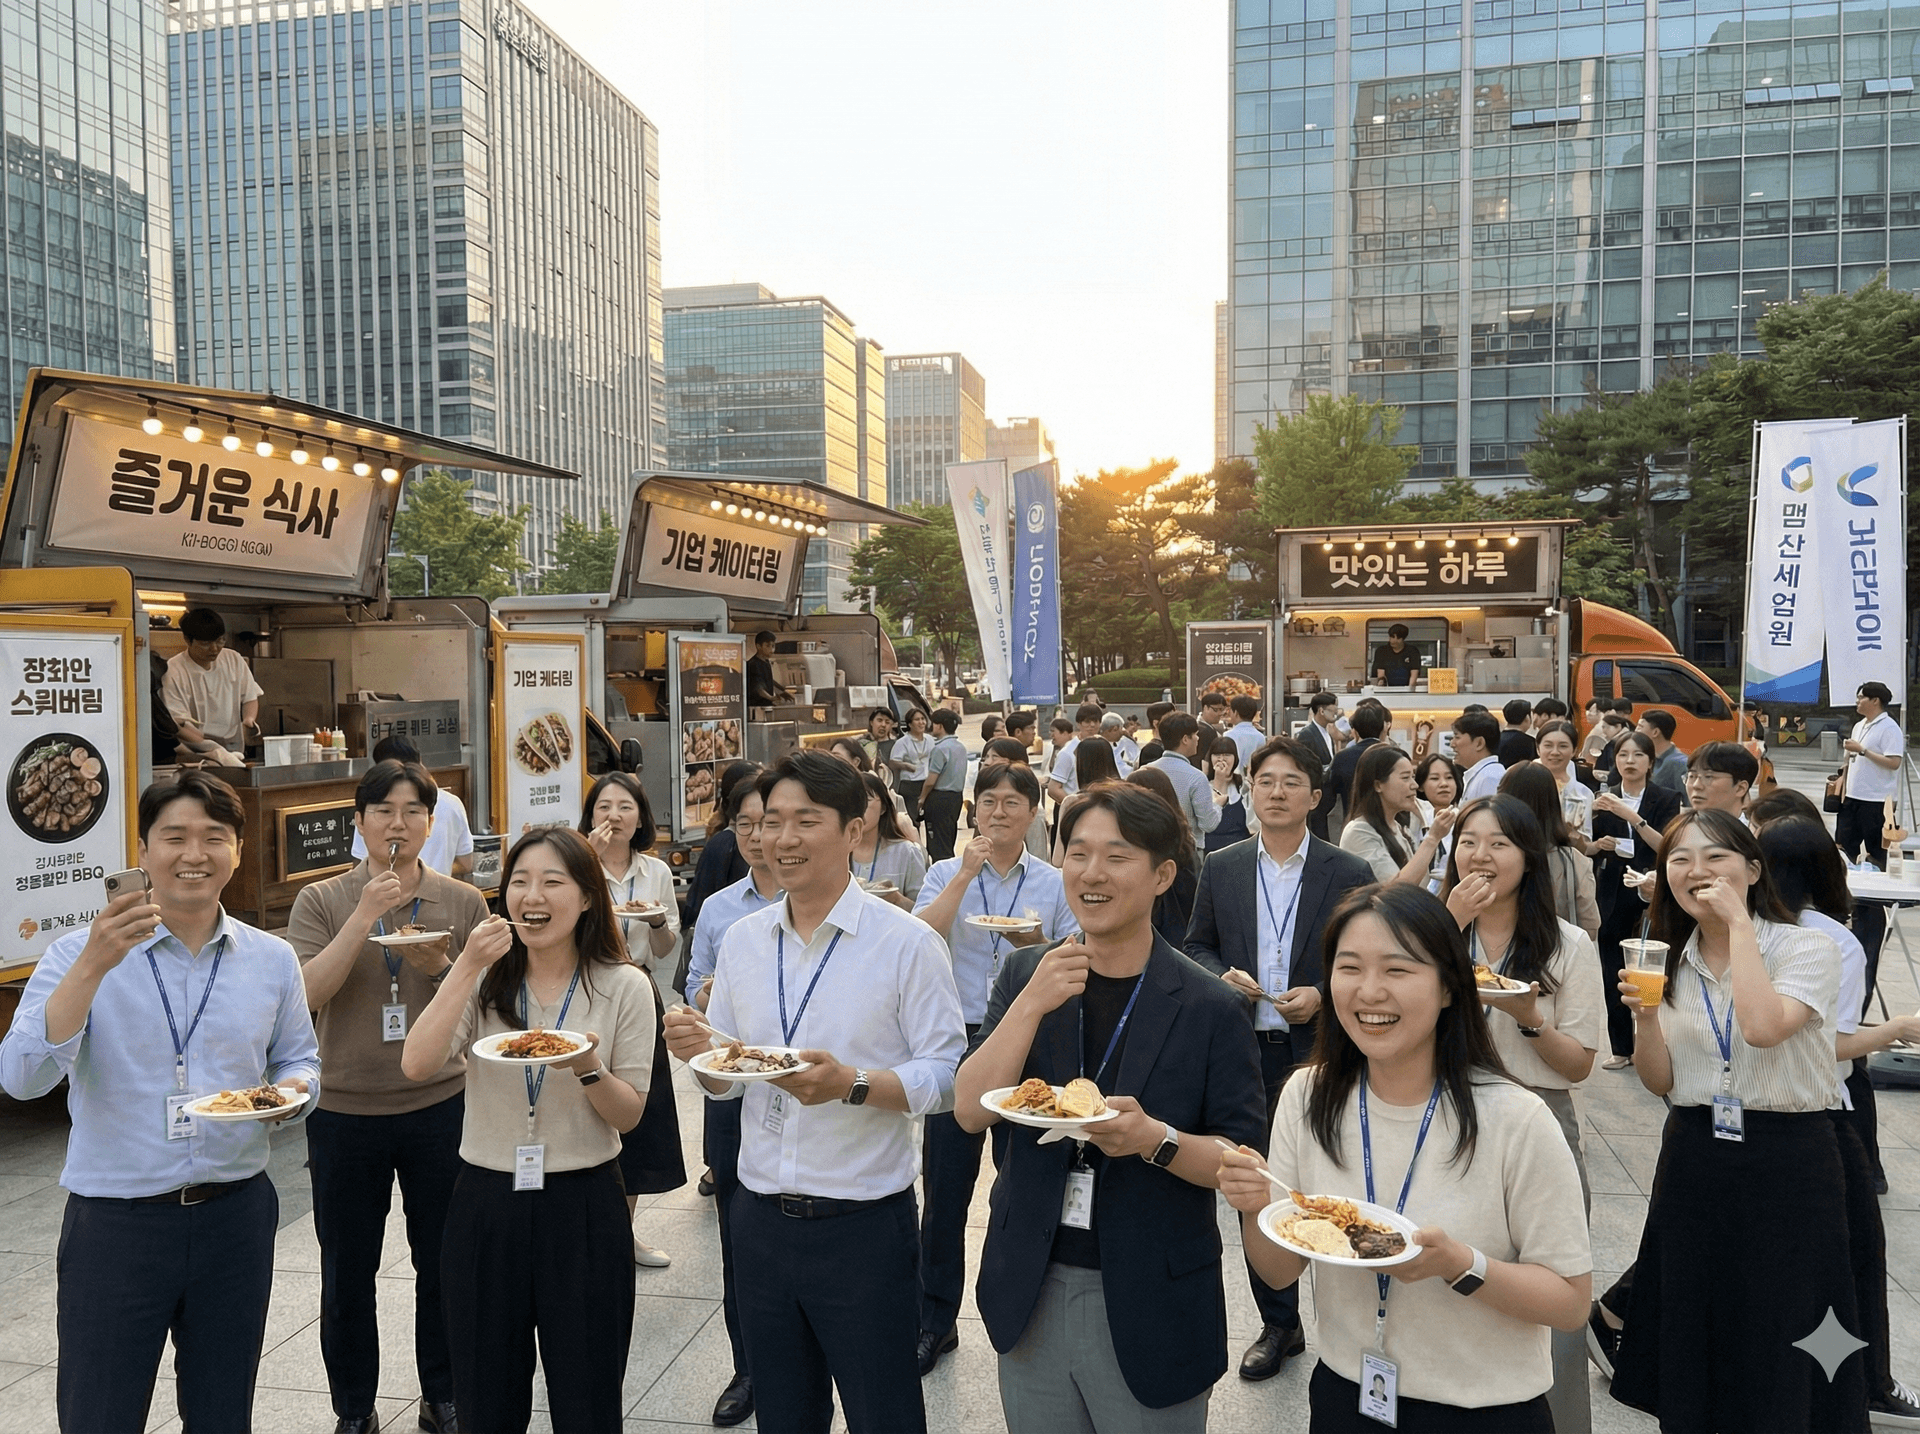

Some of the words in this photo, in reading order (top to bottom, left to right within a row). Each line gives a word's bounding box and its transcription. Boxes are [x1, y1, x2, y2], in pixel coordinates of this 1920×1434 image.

[108, 448, 252, 527] 즐거운
[263, 478, 340, 539] 식사
[661, 528, 706, 573] 기업
[708, 537, 782, 584] 케이터링
[1329, 554, 1429, 589] 맛있는
[1439, 552, 1508, 585] 하루
[513, 670, 537, 687] 기업
[540, 670, 573, 687] 케터링
[72, 866, 104, 882] BBQ
